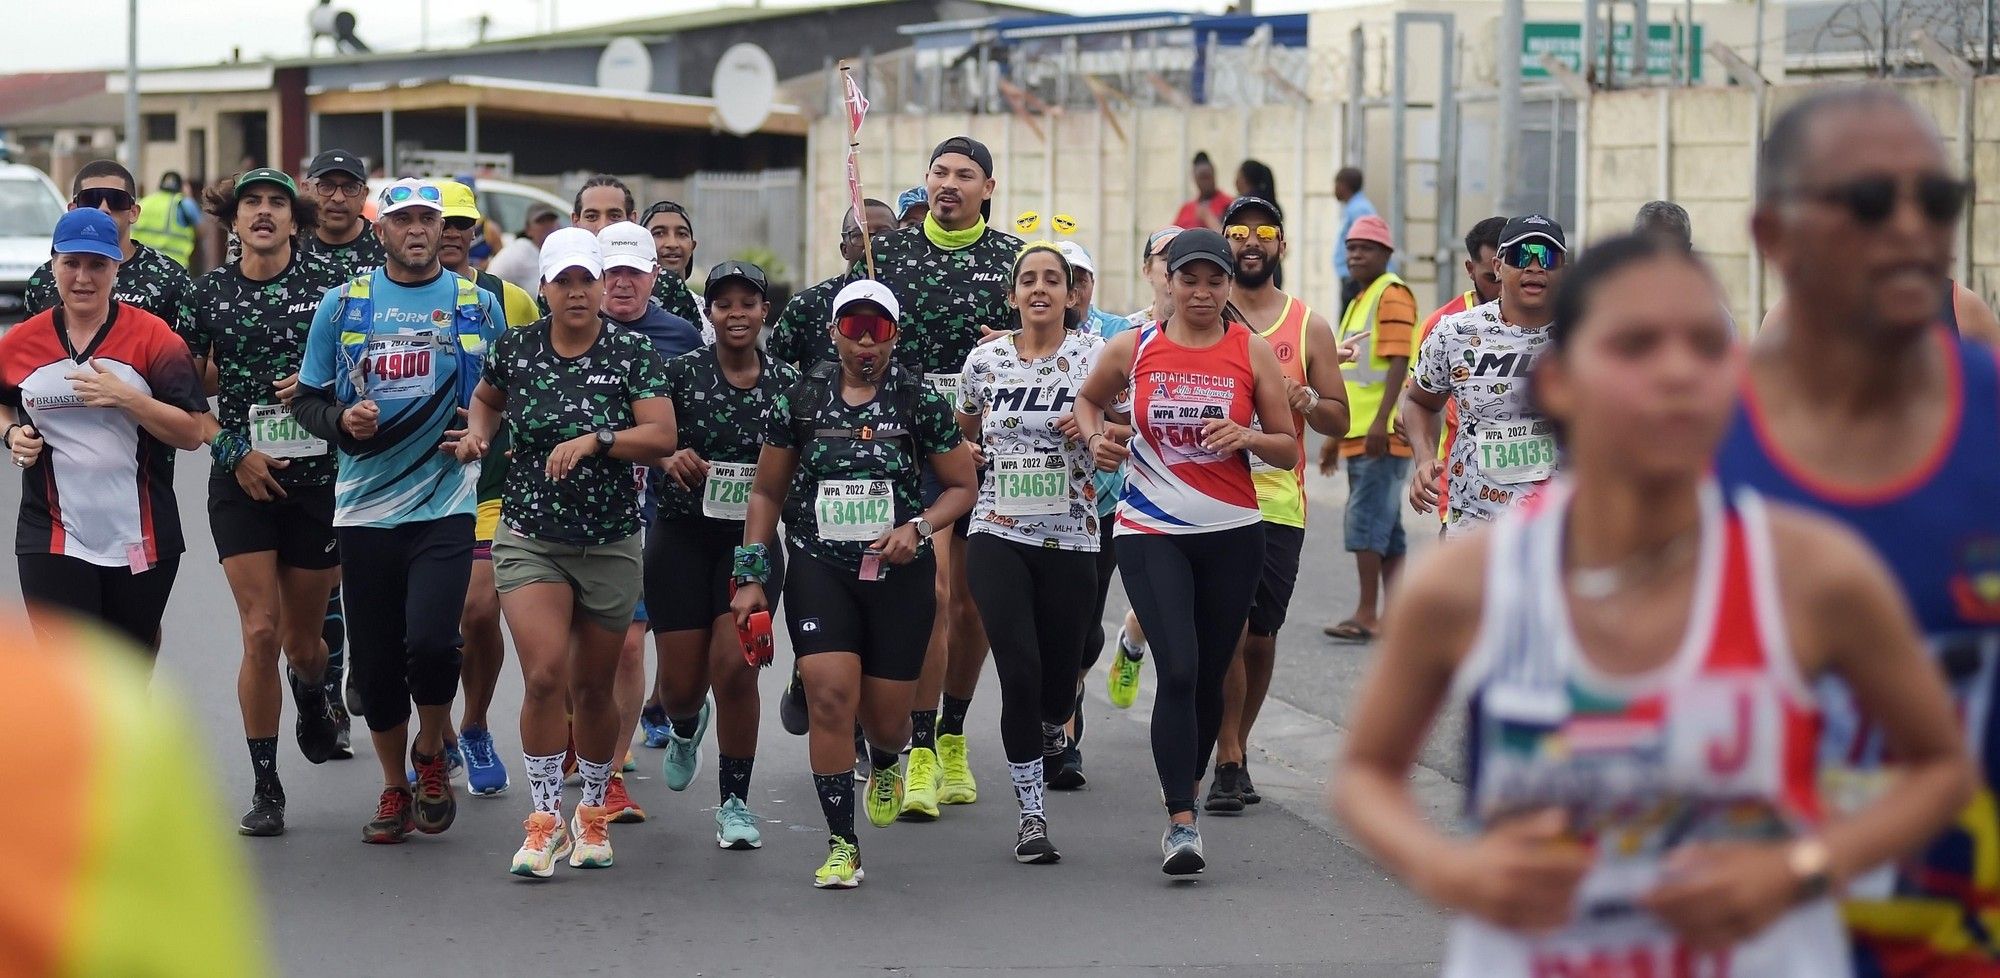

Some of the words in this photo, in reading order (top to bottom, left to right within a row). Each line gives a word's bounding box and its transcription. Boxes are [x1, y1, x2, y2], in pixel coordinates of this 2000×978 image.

[971, 272, 1004, 282] MLH
[112, 292, 146, 303] MLH
[287, 301, 320, 314] MLH
[384, 307, 430, 323] FORM
[369, 341, 386, 351] WPA
[363, 351, 431, 383] P4900
[1474, 353, 1535, 378] ML
[586, 374, 622, 385] MLH
[939, 377, 957, 387] 2022
[1149, 372, 1167, 383] ARD
[1168, 372, 1210, 386] ATHLETIC
[1211, 375, 1235, 388] CLUB
[36, 395, 86, 405] BRIMSTO
[992, 387, 1080, 412] MLH
[257, 408, 276, 417] WPA
[1153, 410, 1174, 419] WPA
[1179, 407, 1199, 418] 2022
[1203, 407, 1222, 415] ASA
[1485, 431, 1503, 440] WPA
[1507, 425, 1527, 438] 2022
[1481, 438, 1554, 469] T34133
[1001, 460, 1018, 470] WPA
[1022, 458, 1041, 468] 2022
[1047, 456, 1063, 464] ASA
[715, 468, 735, 477] WPA
[823, 487, 840, 496] WPA
[845, 484, 865, 495] 2022
[870, 481, 887, 490] ASA
[998, 472, 1066, 498] T34637
[1479, 484, 1514, 505] BOO!
[819, 498, 890, 526] T34142
[1053, 524, 1073, 533] MLH
